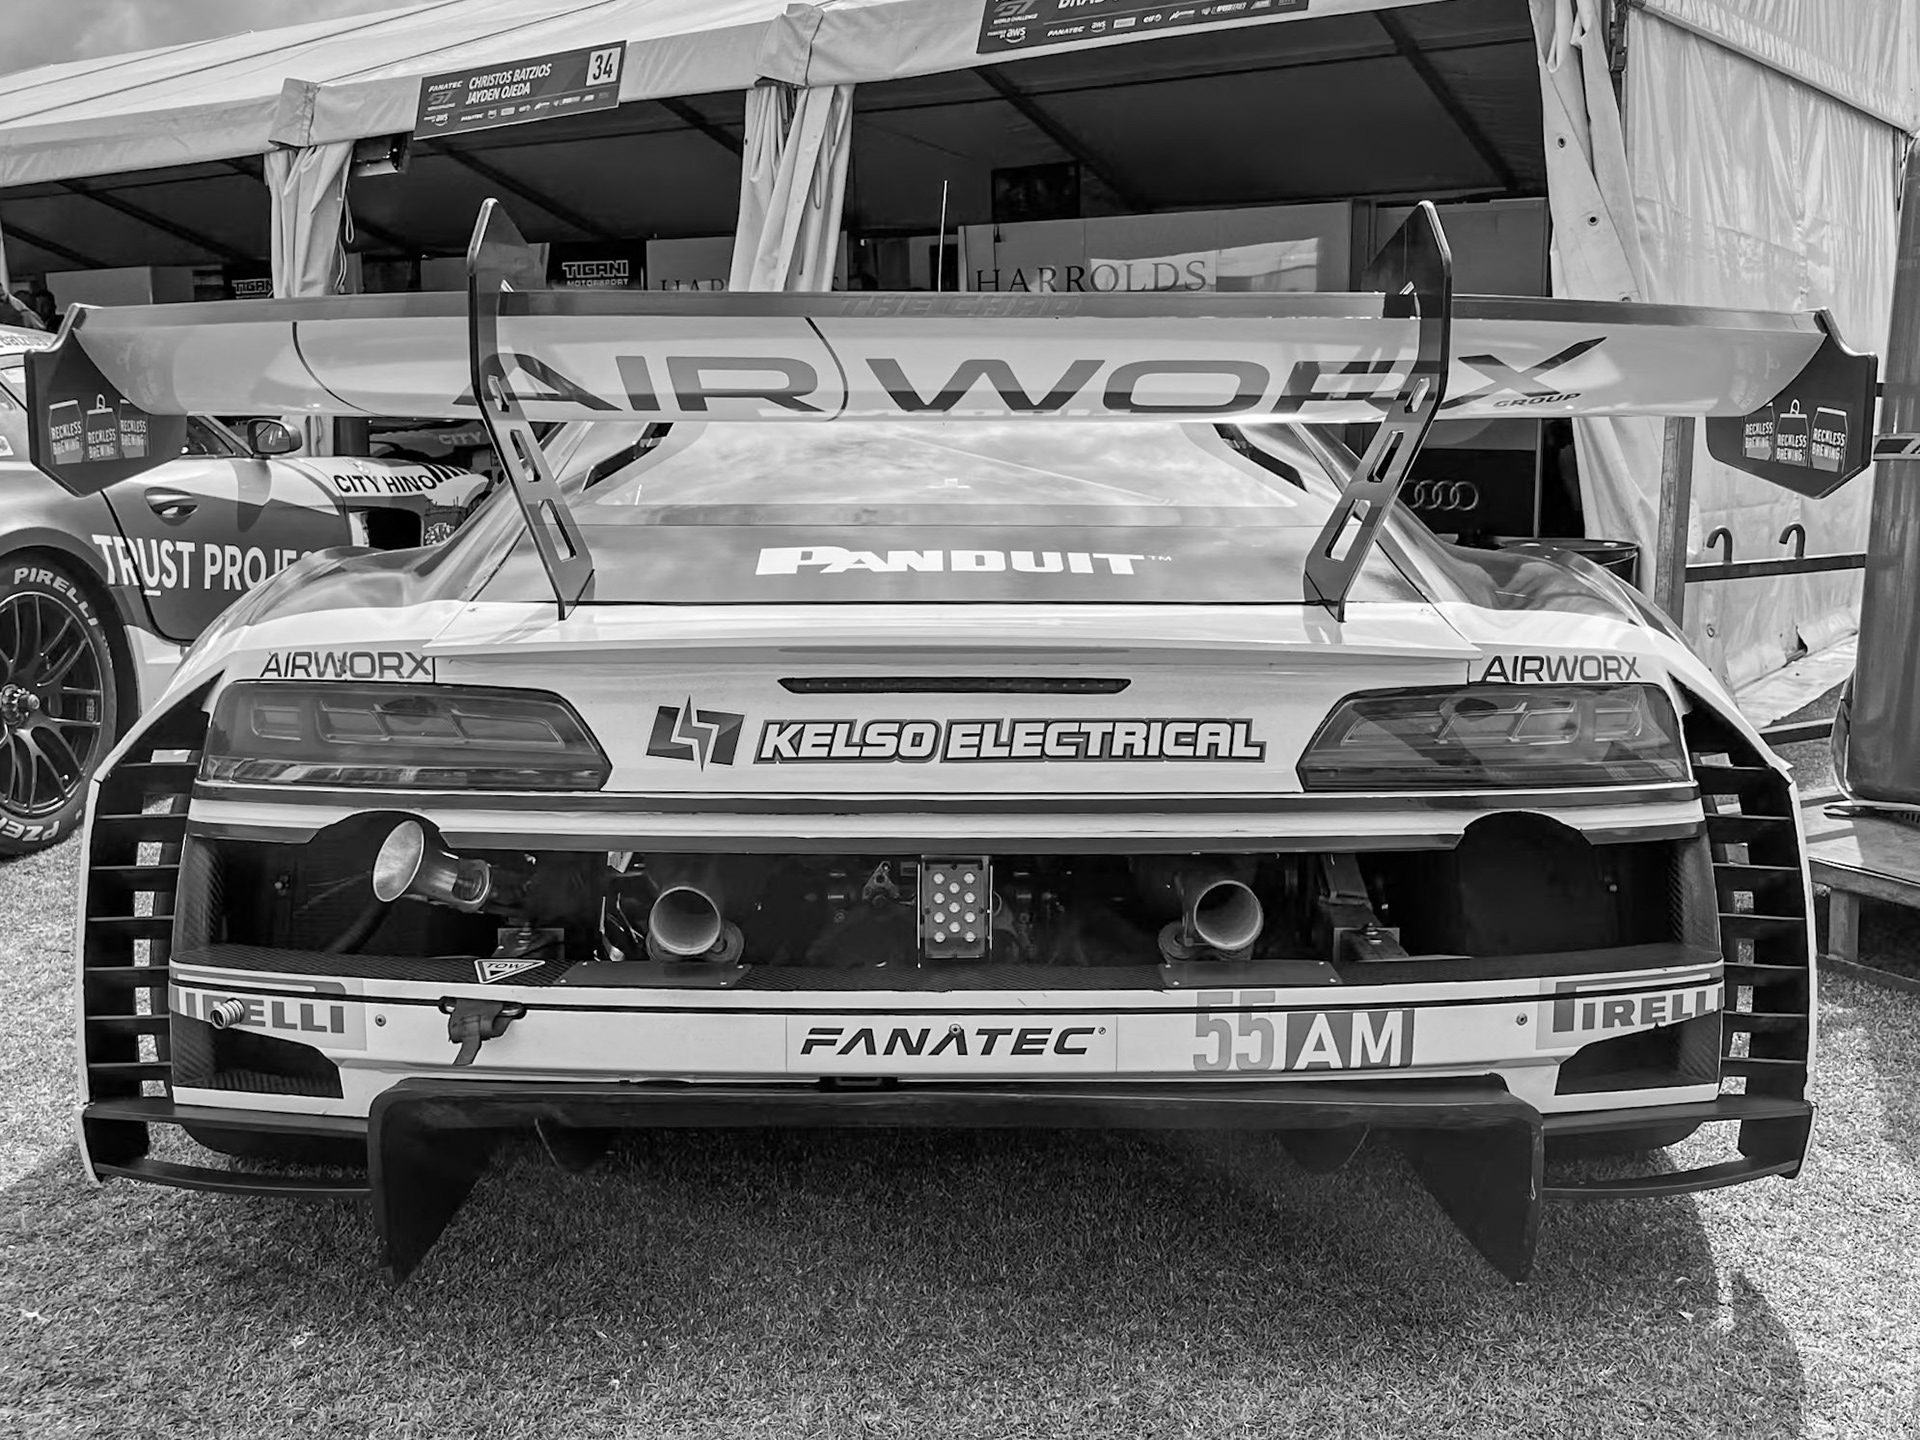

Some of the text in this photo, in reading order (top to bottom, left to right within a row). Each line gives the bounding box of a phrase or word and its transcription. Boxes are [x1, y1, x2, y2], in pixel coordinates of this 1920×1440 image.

[1010, 13, 1038, 23] CHALLENGE
[1047, 26, 1085, 37] FANATEC
[592, 52, 614, 80] 34
[468, 63, 552, 90] CHRISTOS BATZIOS
[428, 80, 463, 93] FANATEC
[465, 82, 531, 105] JAYDEN OJEDA
[562, 260, 629, 278] TIGANI
[976, 259, 1208, 292] HARROLDS
[566, 278, 629, 287] MOTORSPORT
[453, 336, 1608, 414] AIRWORX
[1492, 392, 1582, 408] GROUP
[51, 421, 82, 439] RECKLESS
[120, 419, 147, 433] RECKLESS
[1745, 422, 1773, 435] RECKLESS
[87, 428, 116, 444] RECKLESS
[438, 431, 482, 445] CITY
[1777, 433, 1808, 448] RECKLESS
[1812, 428, 1846, 447] RECKLESS
[53, 439, 81, 455] BREWING
[1776, 448, 1805, 461] BREWING
[1811, 443, 1841, 460] BREWING
[333, 474, 438, 495] CITY HINO
[91, 534, 196, 596] TRUST
[755, 545, 1146, 576] PANDUIT
[14, 567, 98, 627] PIRELLI
[260, 651, 432, 679] AIRWORX
[1482, 655, 1641, 682] AIRWORX
[755, 718, 1266, 763] KELSO ELECTRICAL
[1193, 991, 1405, 1071] 55 AM
